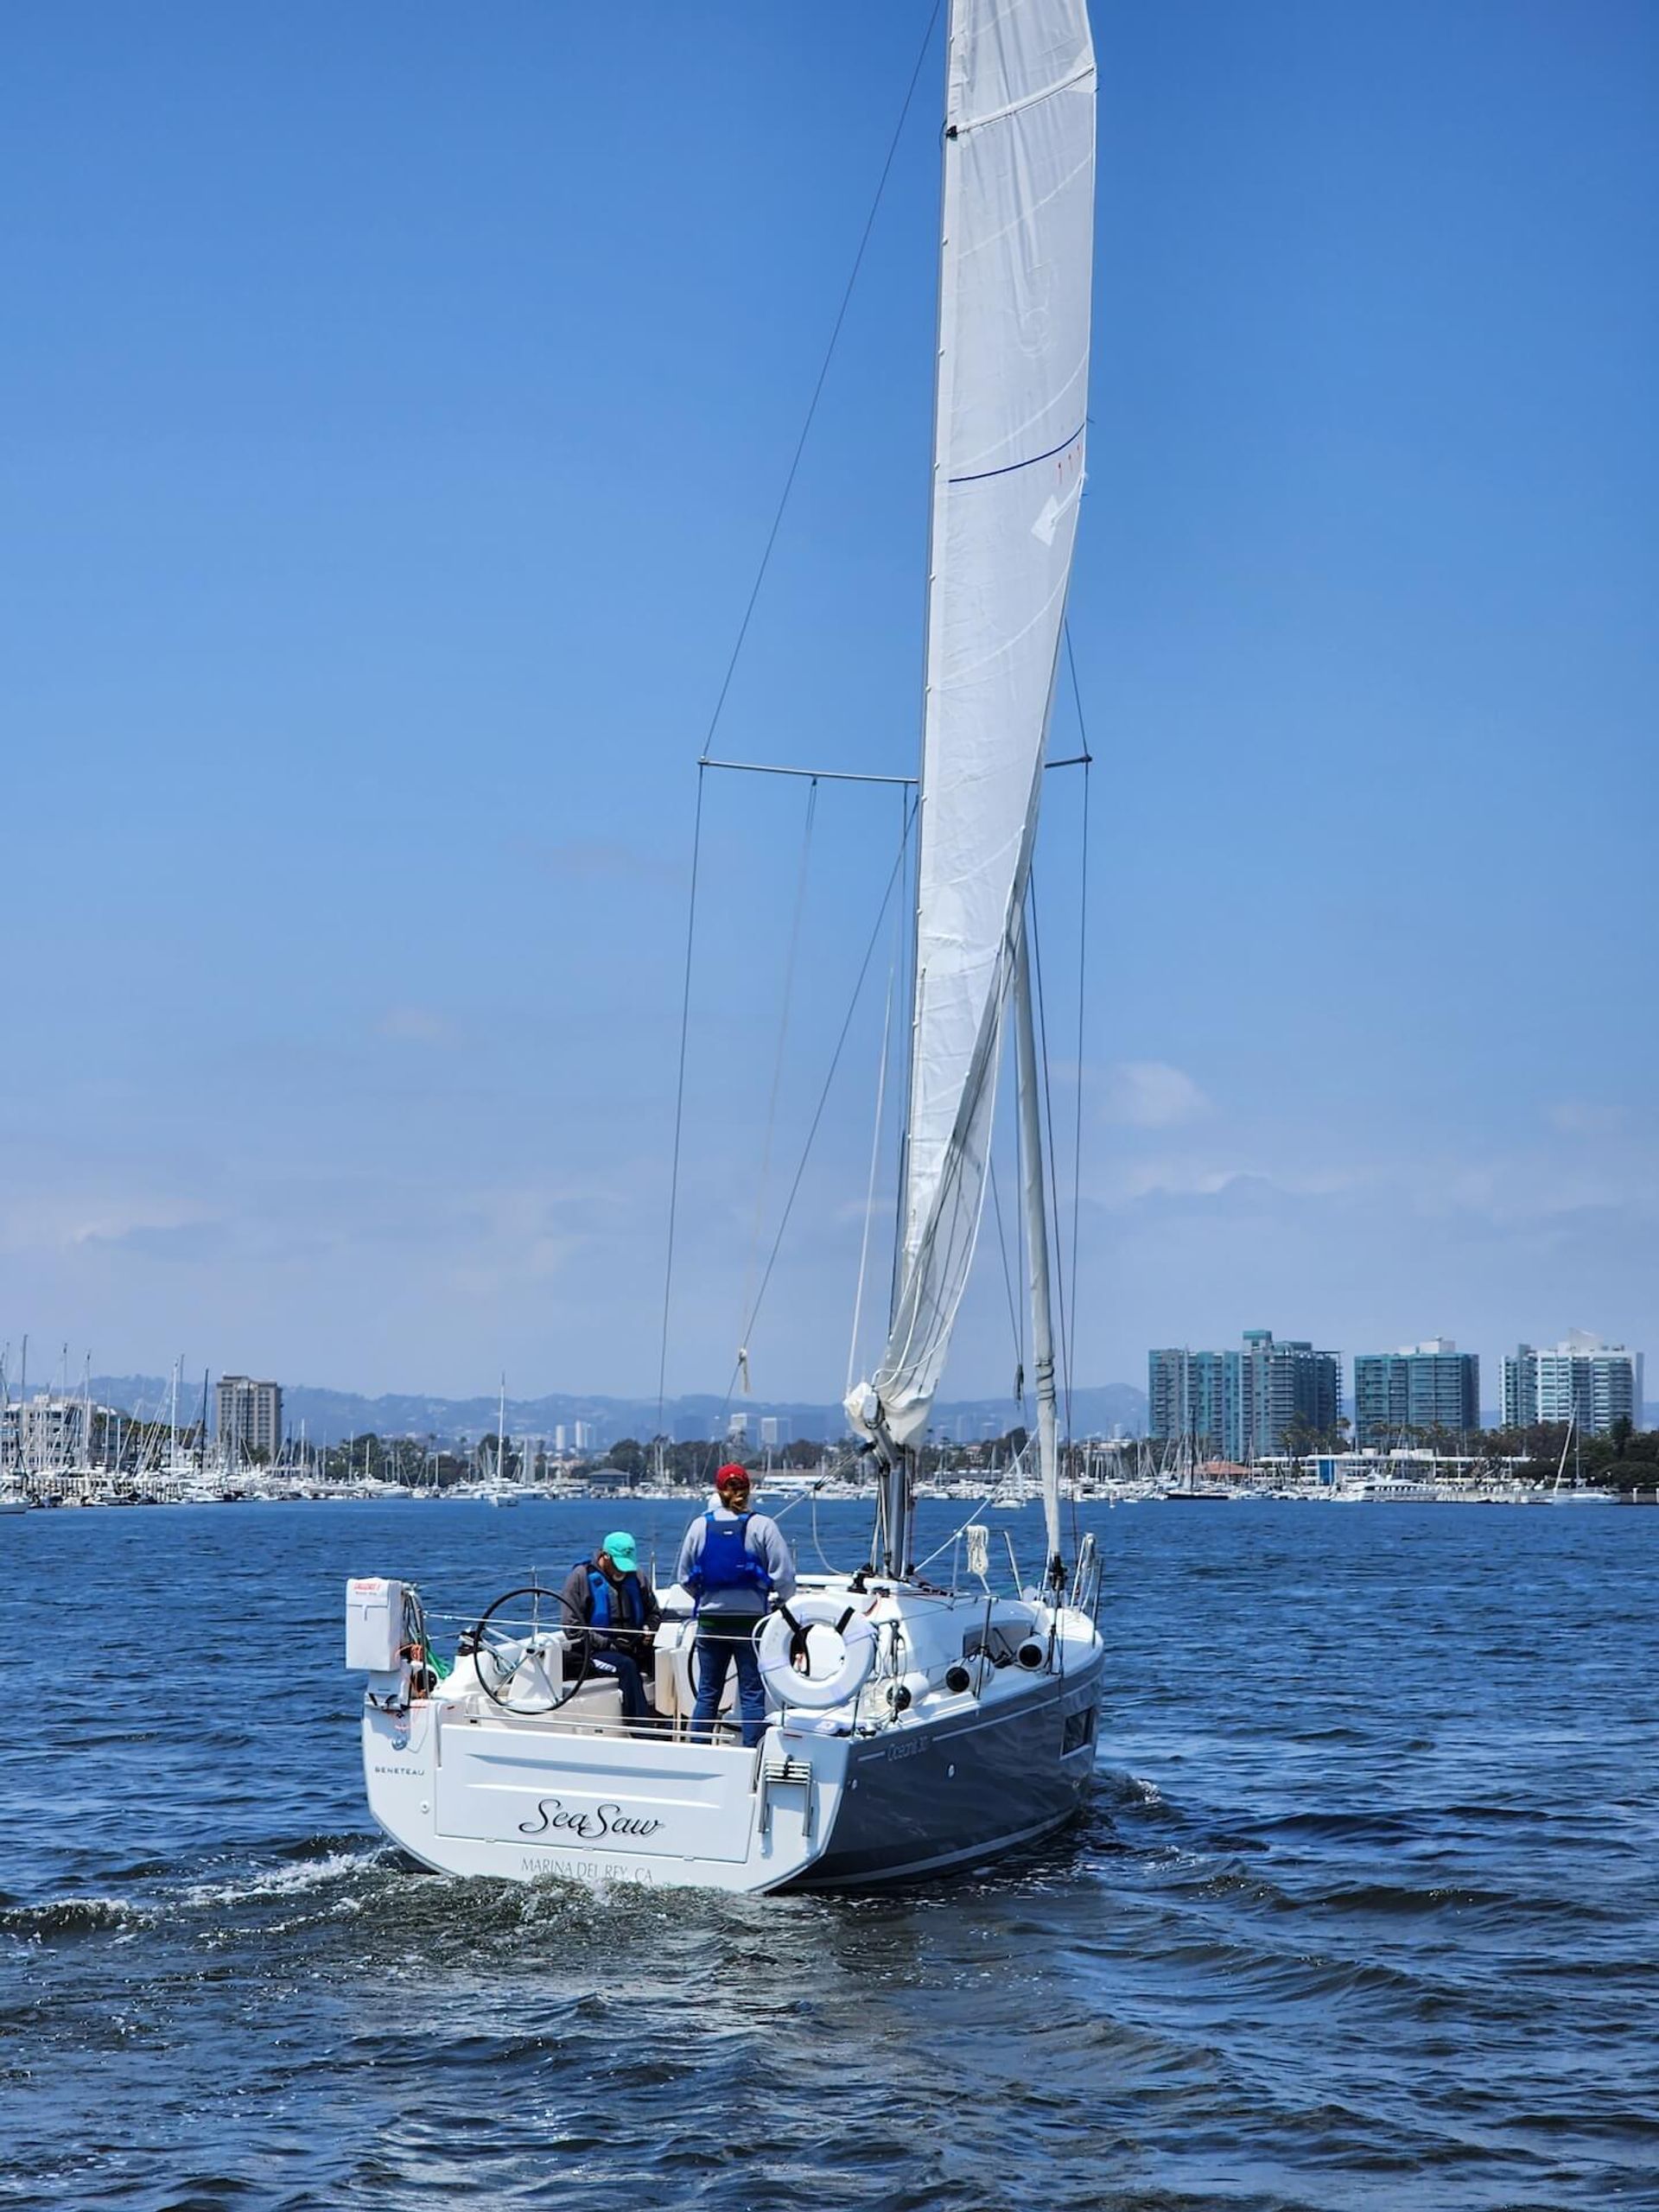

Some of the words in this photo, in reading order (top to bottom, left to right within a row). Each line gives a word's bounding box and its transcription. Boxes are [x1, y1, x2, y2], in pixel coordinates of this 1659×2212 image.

[374, 1766, 425, 1777] BENETEAU
[521, 1858, 574, 1876] MARINA
[576, 1861, 599, 1878] DEL
[634, 1866, 654, 1884] CA
